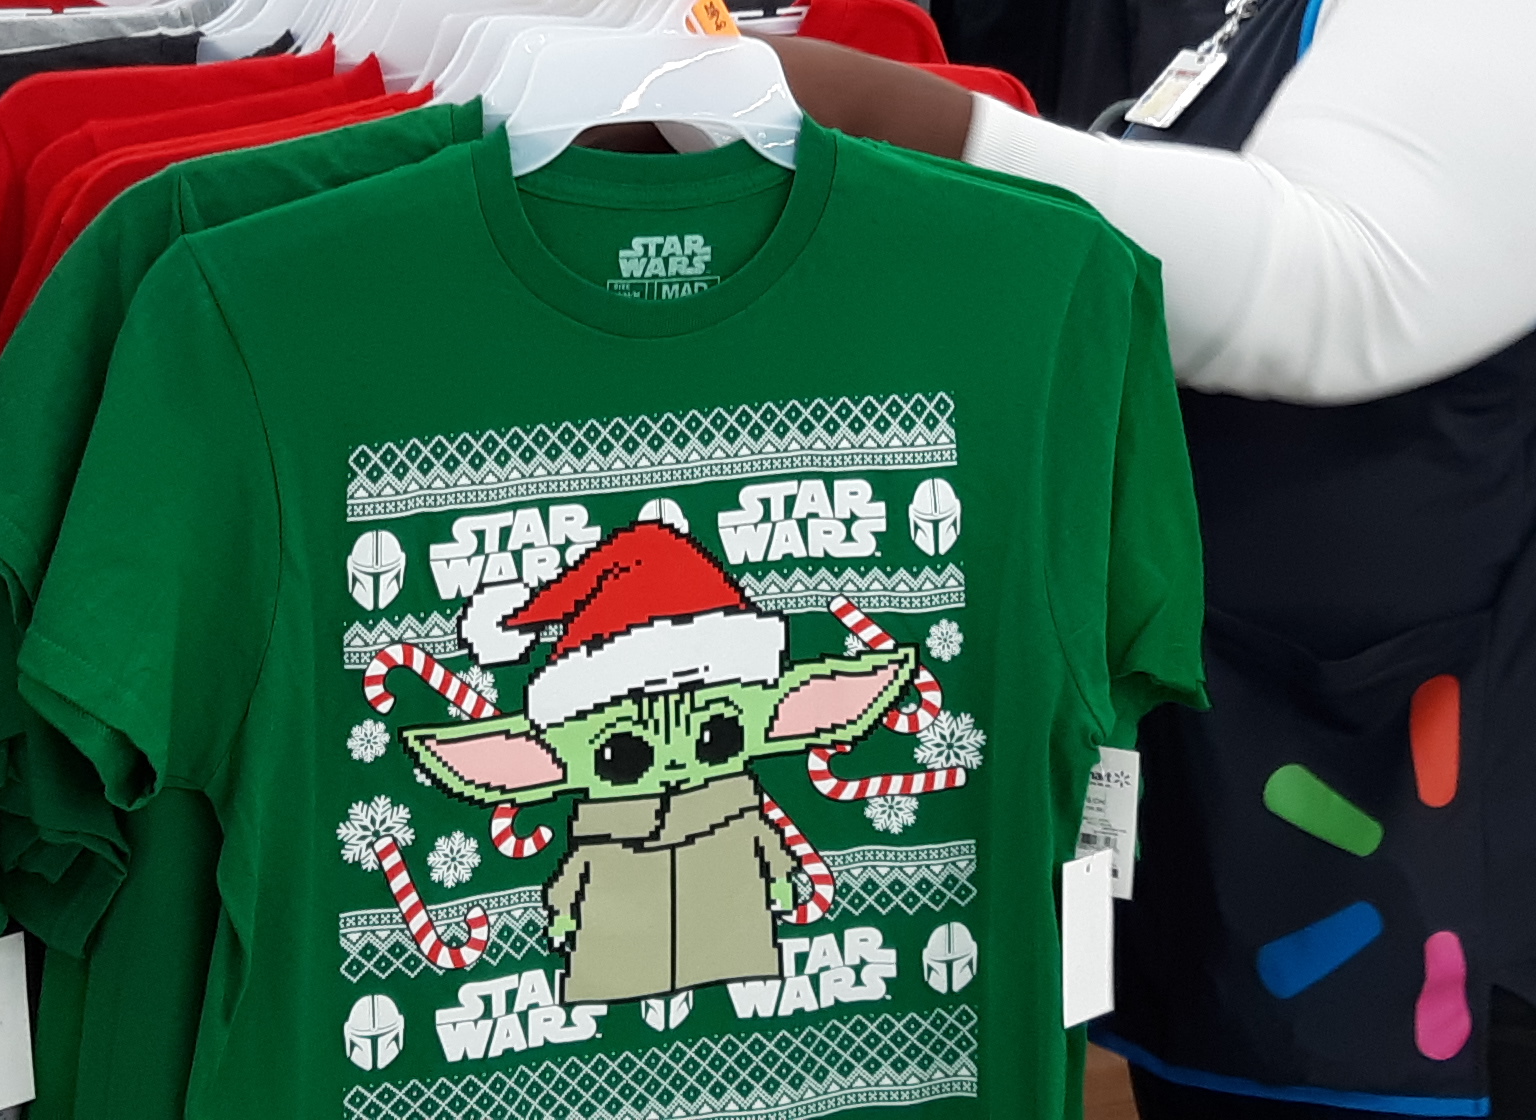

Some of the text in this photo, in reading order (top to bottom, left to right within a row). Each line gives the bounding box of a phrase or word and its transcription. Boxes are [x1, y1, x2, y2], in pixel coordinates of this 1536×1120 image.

[619, 234, 712, 257] STAR
[619, 255, 712, 278] WARS
[430, 503, 600, 560] STAR
[718, 479, 886, 532] STAR
[718, 514, 886, 564] WARS
[782, 926, 897, 980] TAR
[436, 968, 562, 1027] STA
[727, 960, 898, 1020] WARS
[436, 1002, 607, 1064] WARS
